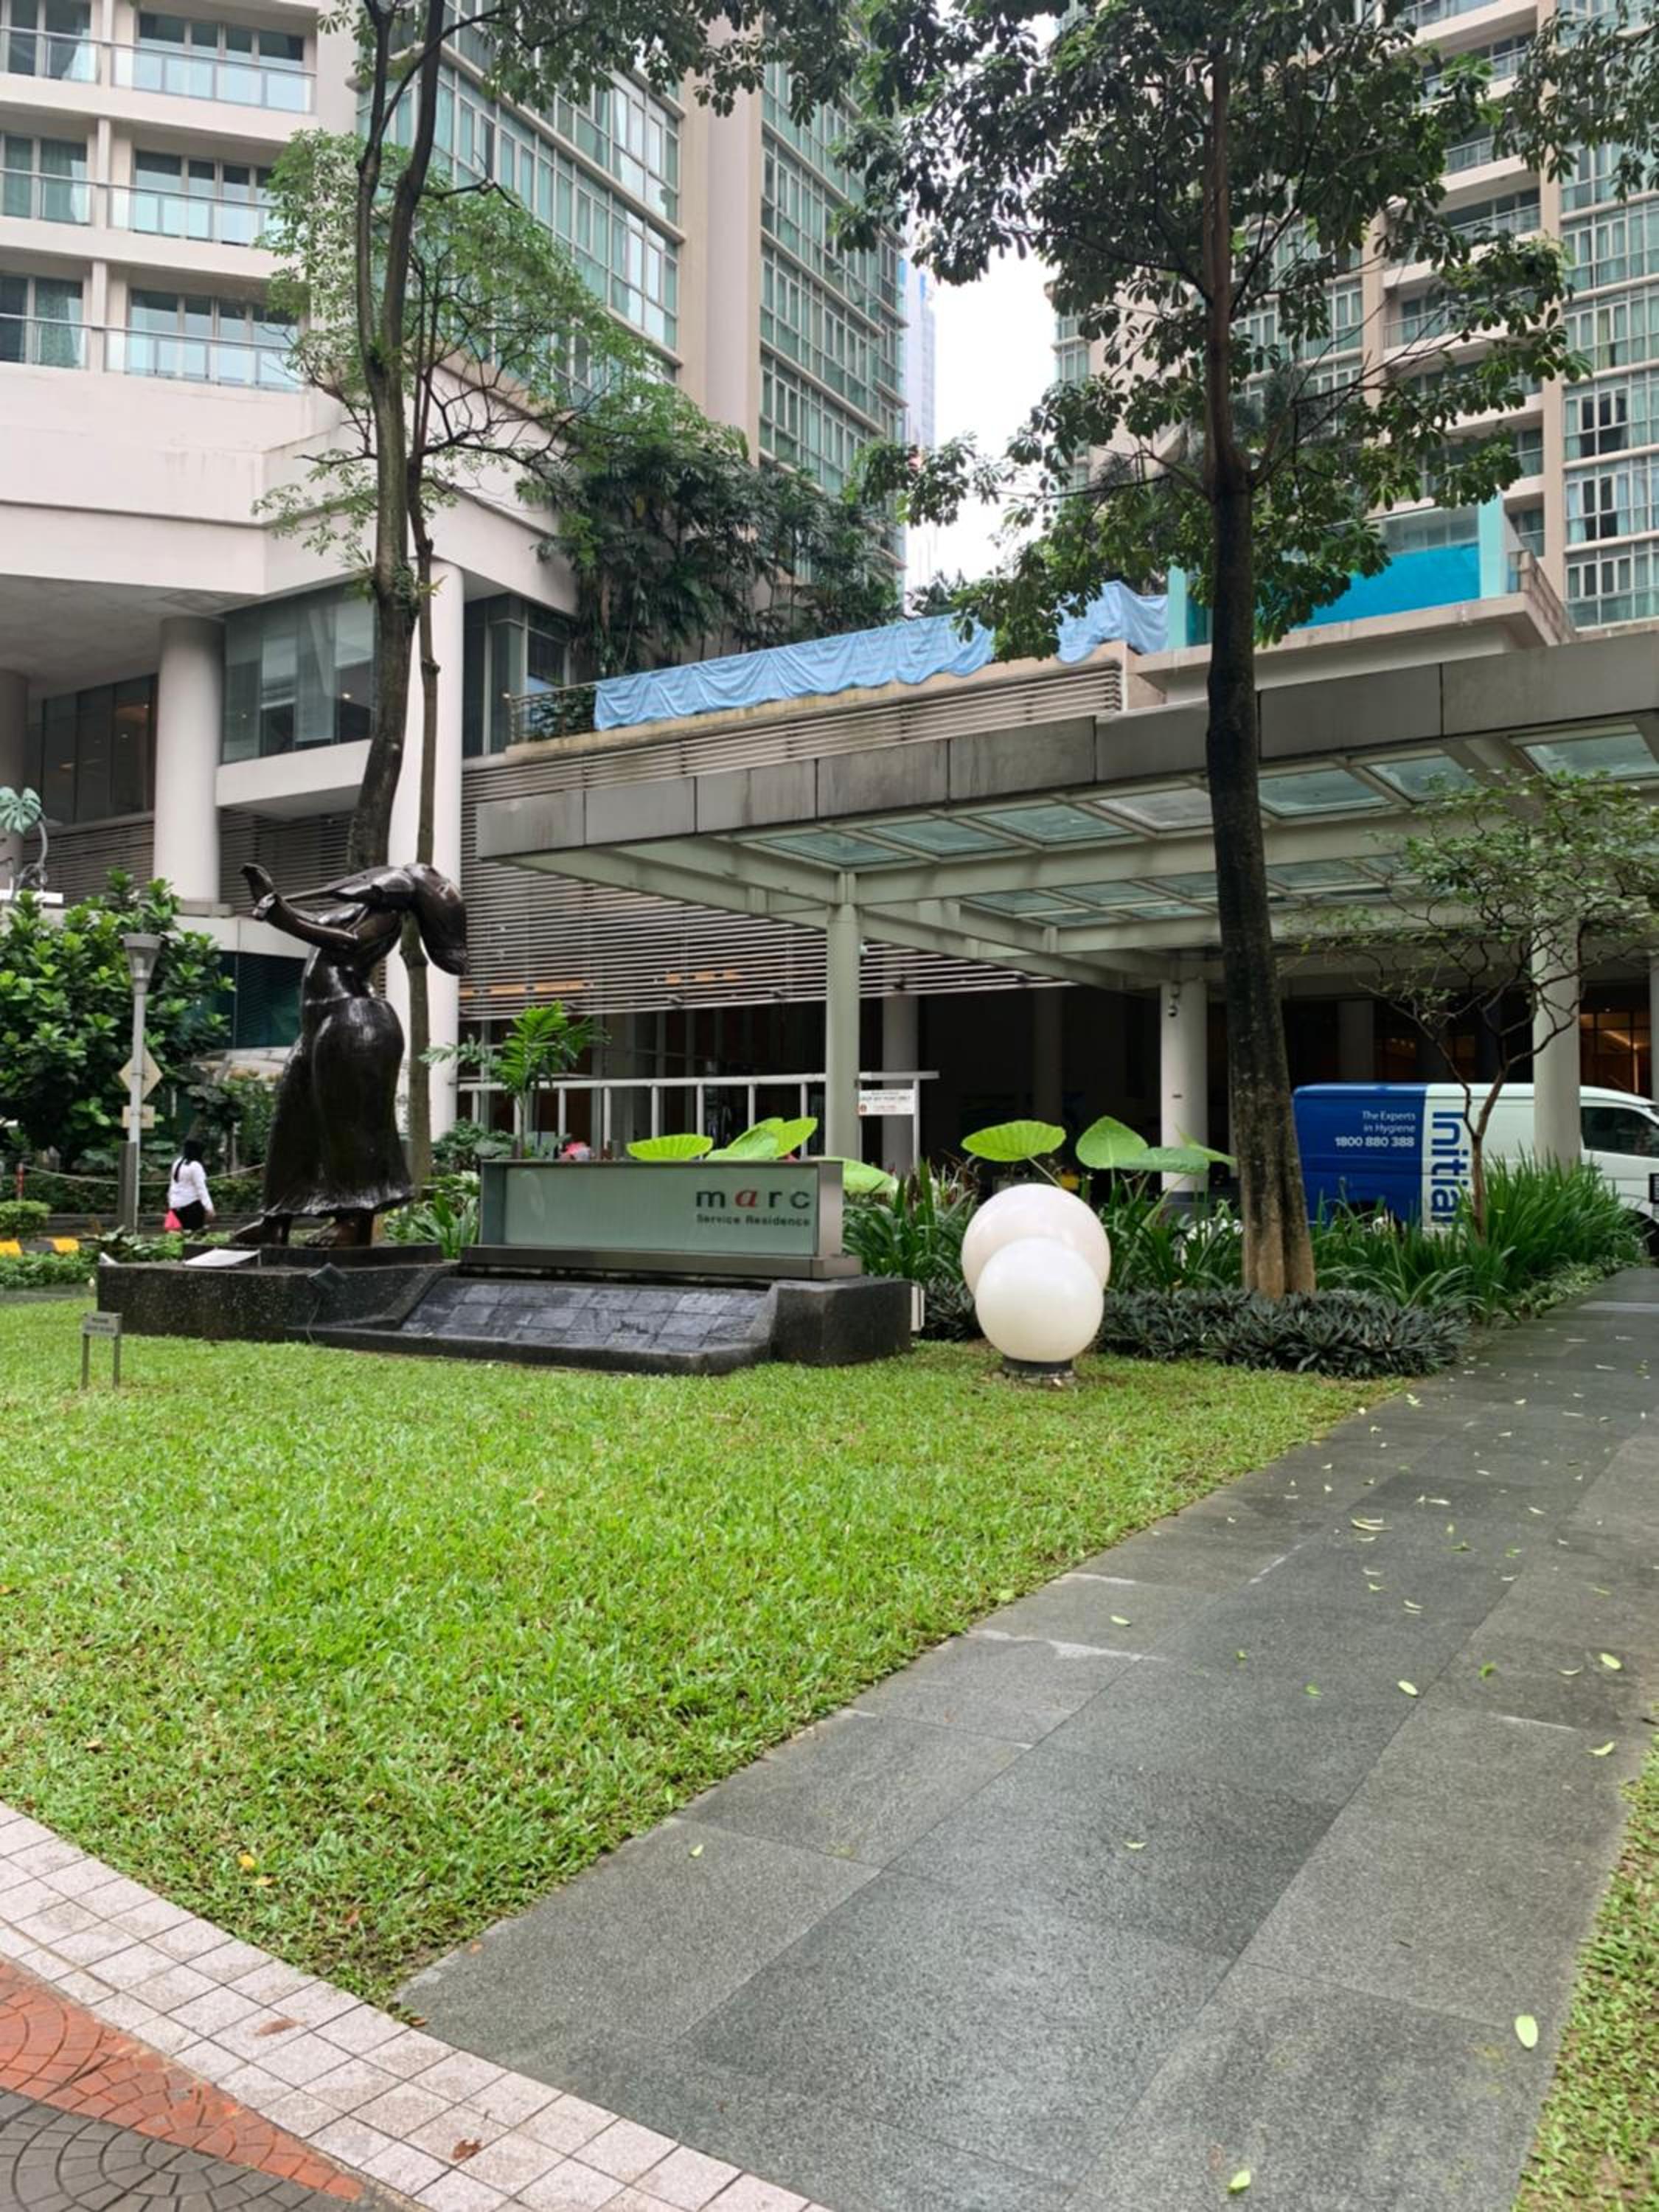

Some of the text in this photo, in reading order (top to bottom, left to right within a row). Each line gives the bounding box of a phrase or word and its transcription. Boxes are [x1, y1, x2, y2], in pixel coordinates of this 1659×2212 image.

[1363, 1110, 1416, 1121] The Experts
[1363, 1124, 1416, 1135] in Hygiene
[1335, 1136, 1363, 1147] 1800
[1365, 1136, 1388, 1147] 880
[695, 1190, 810, 1210] marc
[696, 1214, 810, 1226] Service Residence
